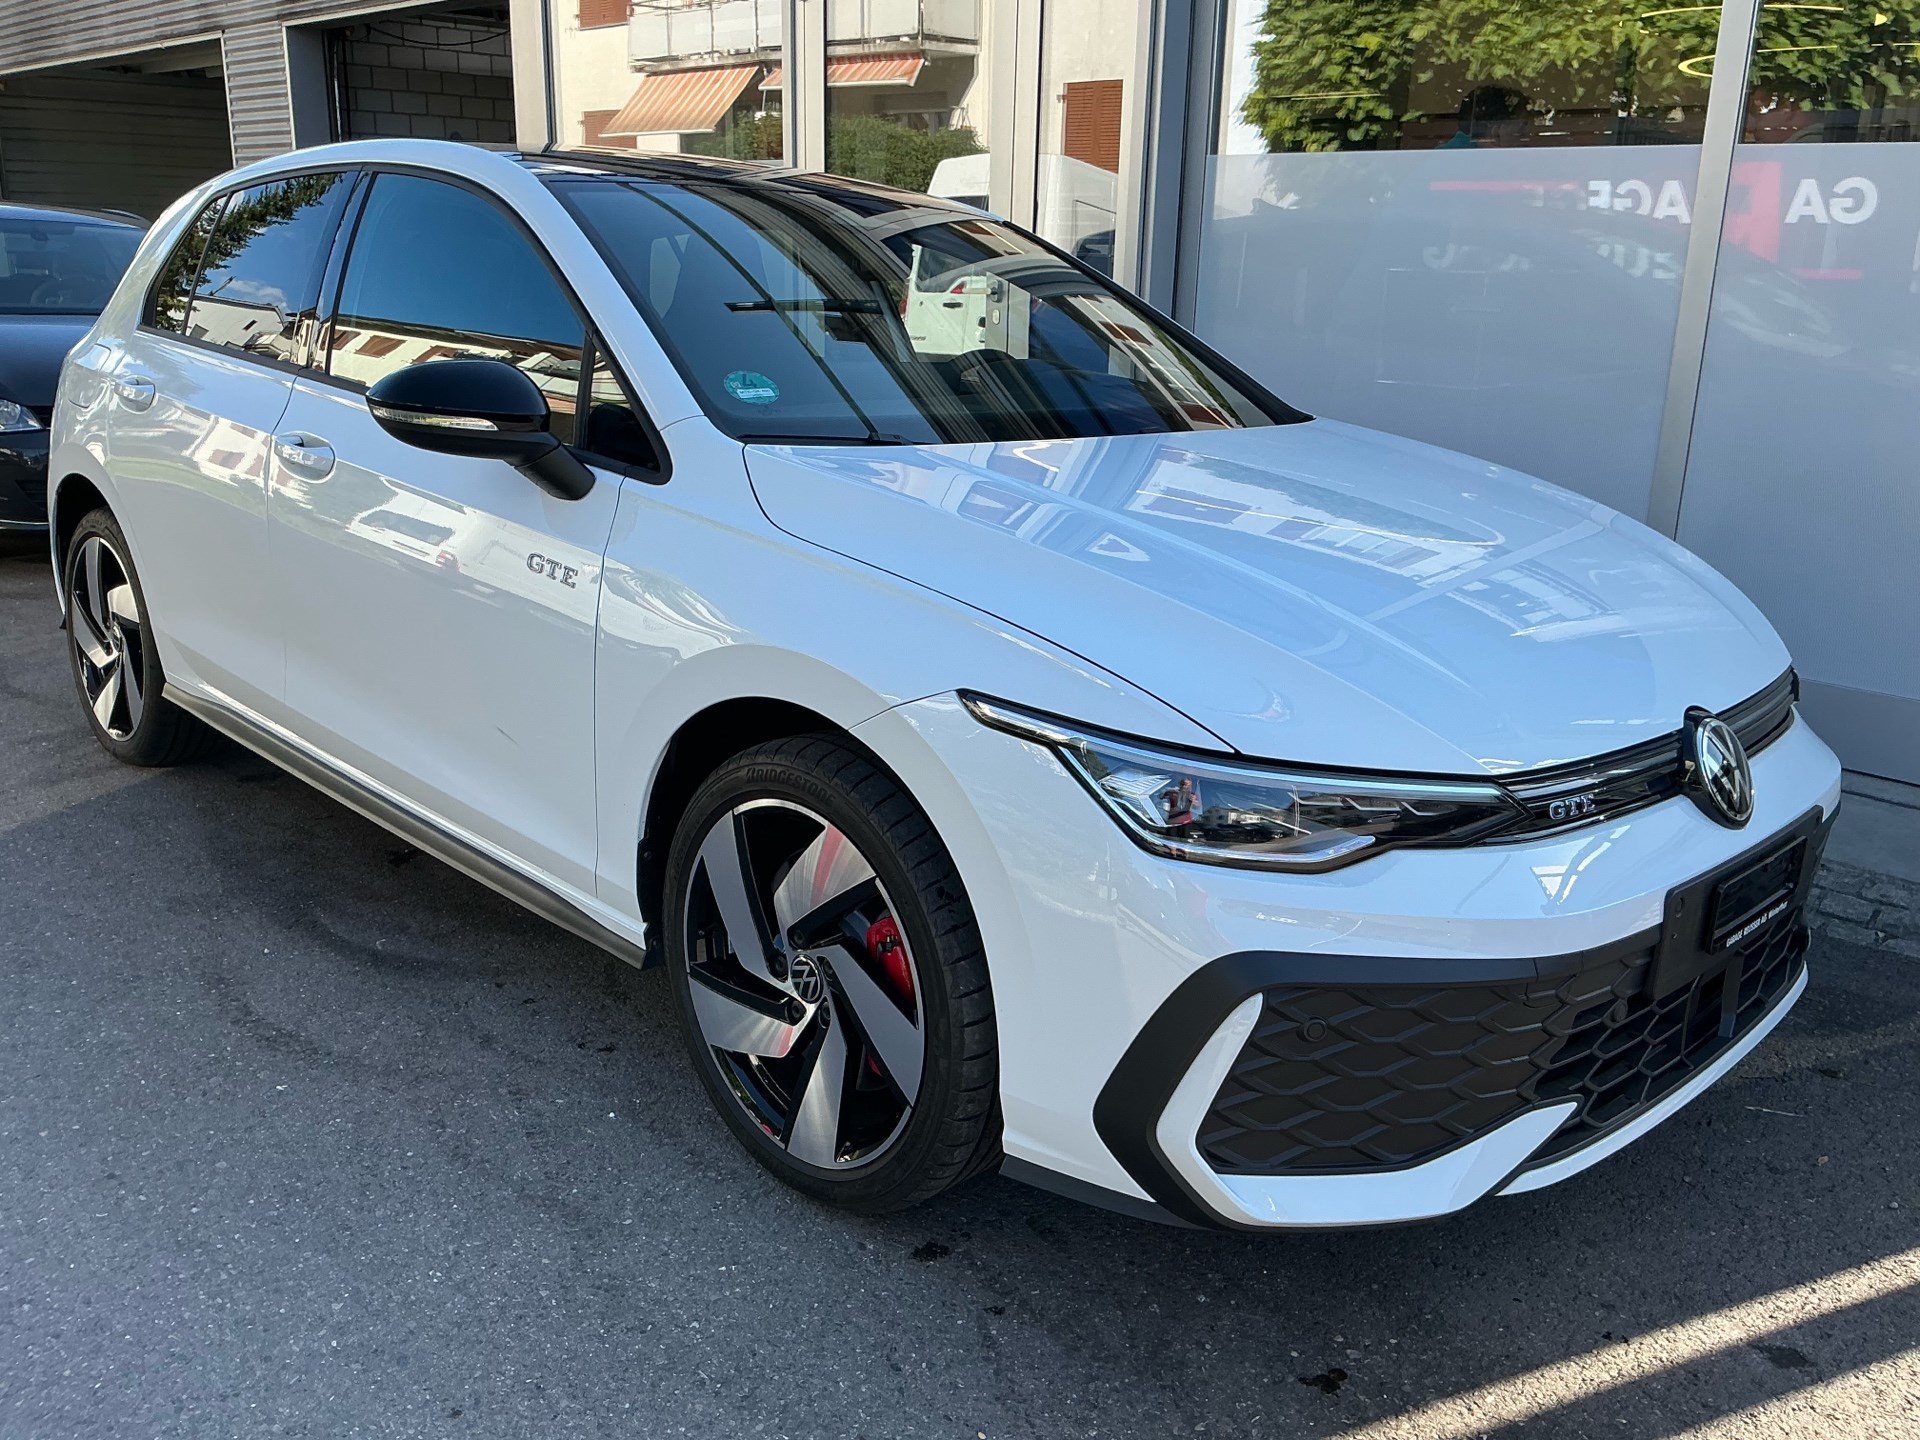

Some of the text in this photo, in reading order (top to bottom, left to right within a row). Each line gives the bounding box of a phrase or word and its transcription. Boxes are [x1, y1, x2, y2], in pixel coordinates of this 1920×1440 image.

[526, 552, 579, 589] GTE
[746, 767, 837, 805] BRIDGESTONE
[1549, 793, 1596, 820] GTE
